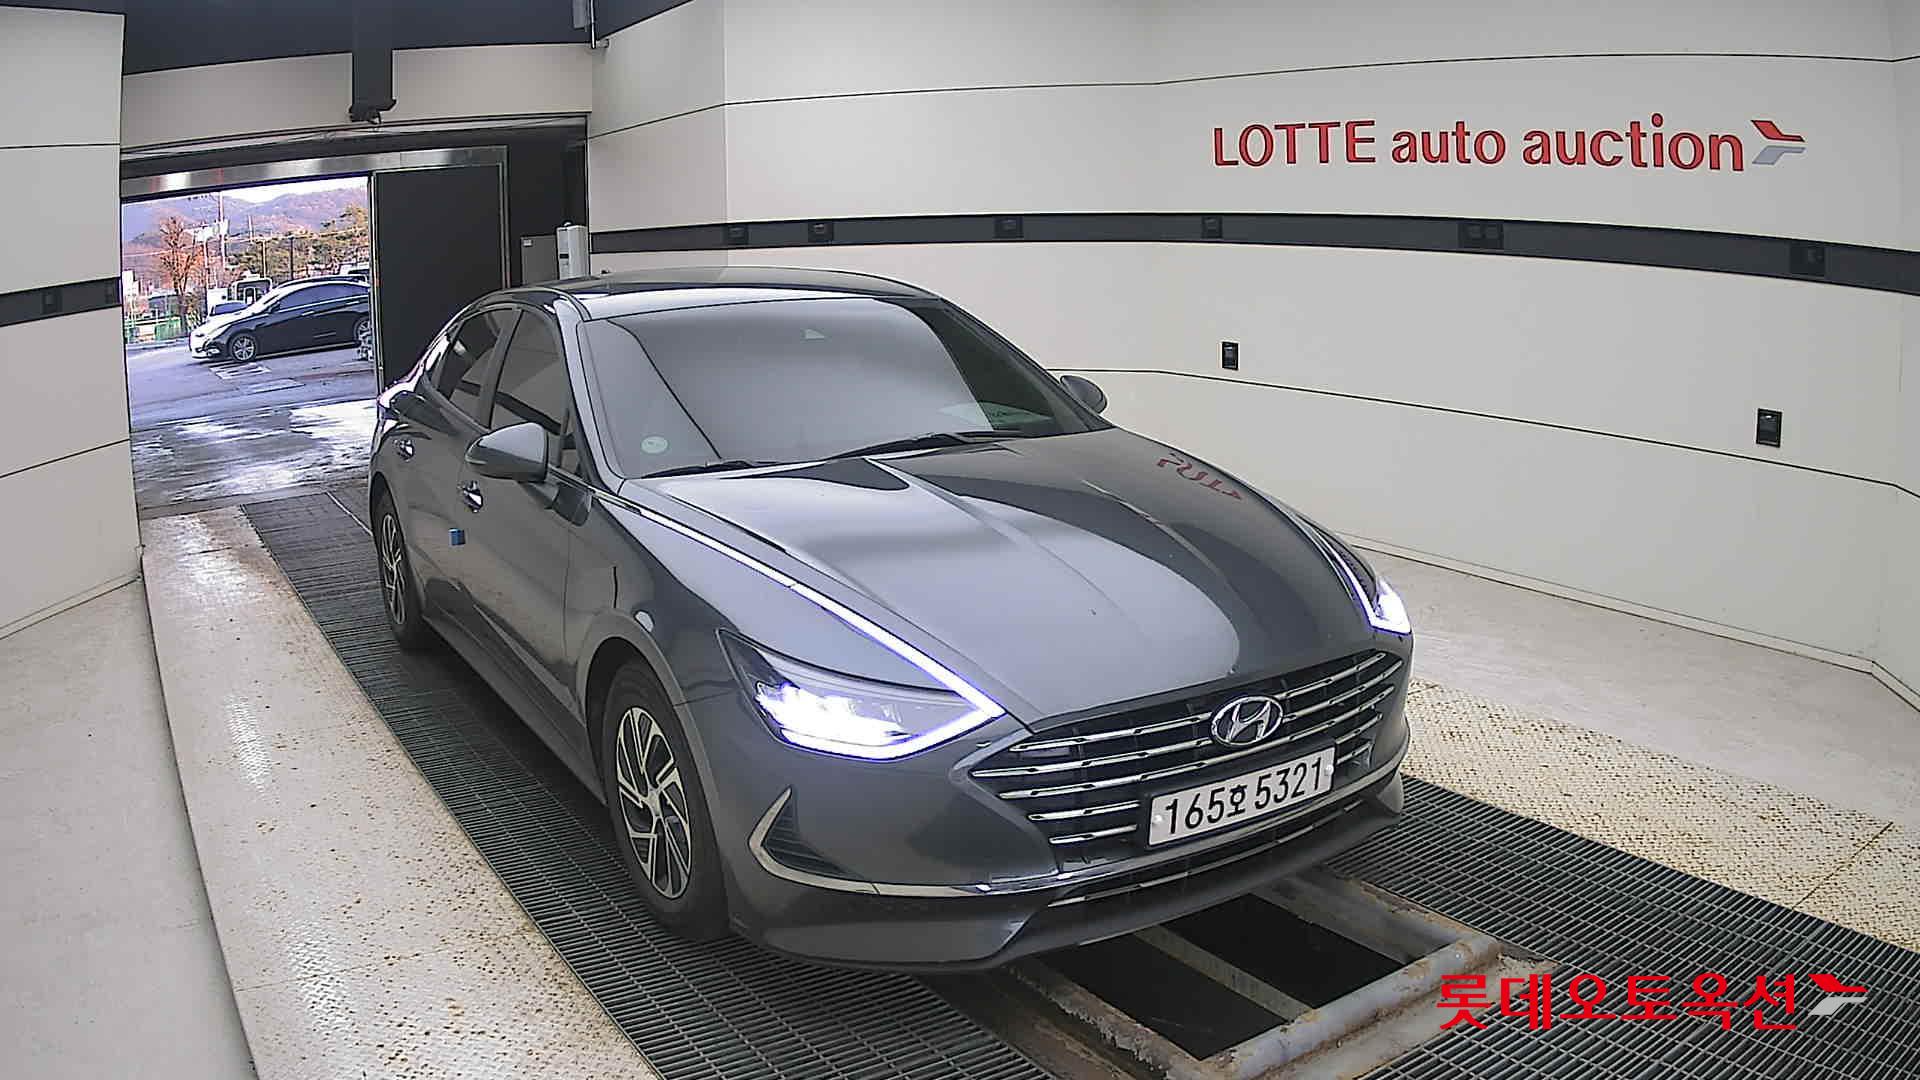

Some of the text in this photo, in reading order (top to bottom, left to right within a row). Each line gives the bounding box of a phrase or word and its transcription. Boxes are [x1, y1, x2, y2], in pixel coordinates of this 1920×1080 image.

[1213, 113, 1745, 172] LOTTE auto auction
[1165, 757, 1322, 834] 165호 5321
